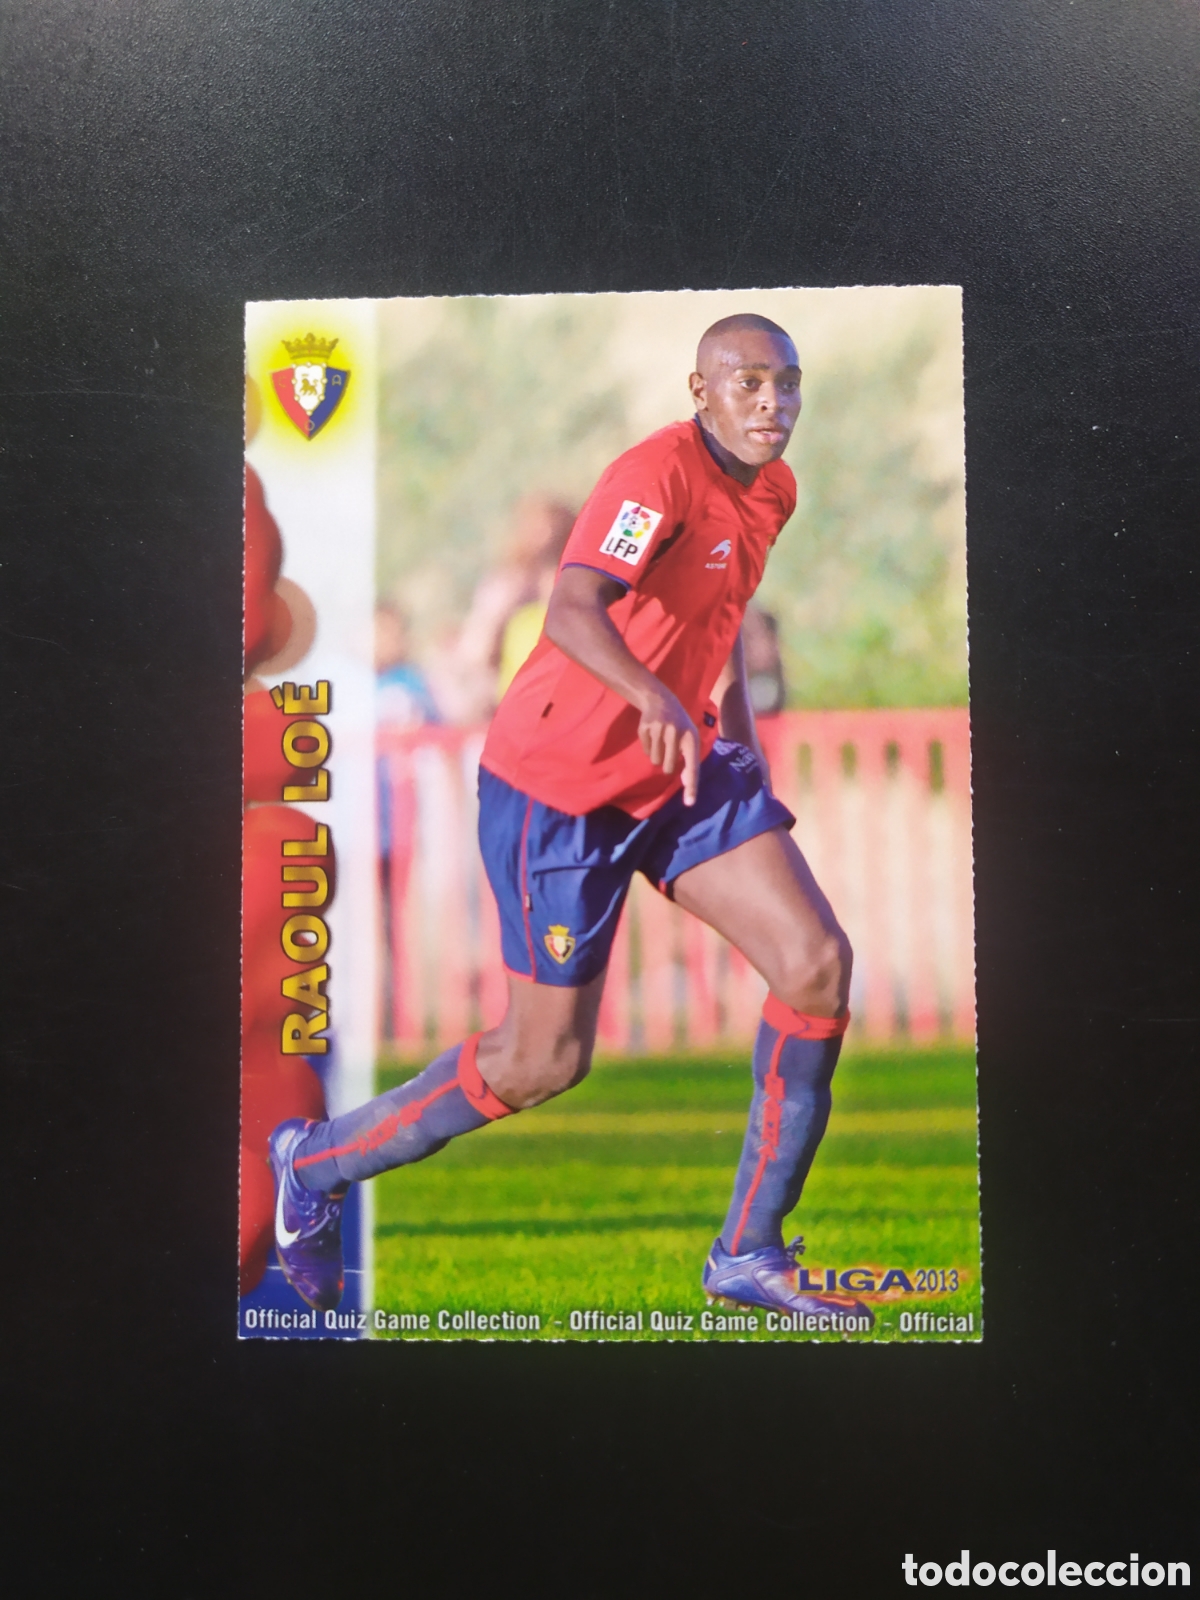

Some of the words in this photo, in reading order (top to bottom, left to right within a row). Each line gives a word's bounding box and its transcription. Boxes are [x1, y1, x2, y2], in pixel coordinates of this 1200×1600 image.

[605, 537, 638, 558] LFP
[269, 679, 330, 803] LOÉ
[281, 822, 330, 1056] RAOUL
[244, 1308, 317, 1330] Official
[324, 1309, 367, 1332] Quiz
[374, 1309, 430, 1331] Game
[437, 1309, 541, 1331] Collection
[569, 1309, 643, 1332] Official
[650, 1310, 693, 1333] Quiz
[700, 1310, 758, 1332] Game
[765, 1310, 870, 1333] Collection
[899, 1311, 975, 1333] Official
